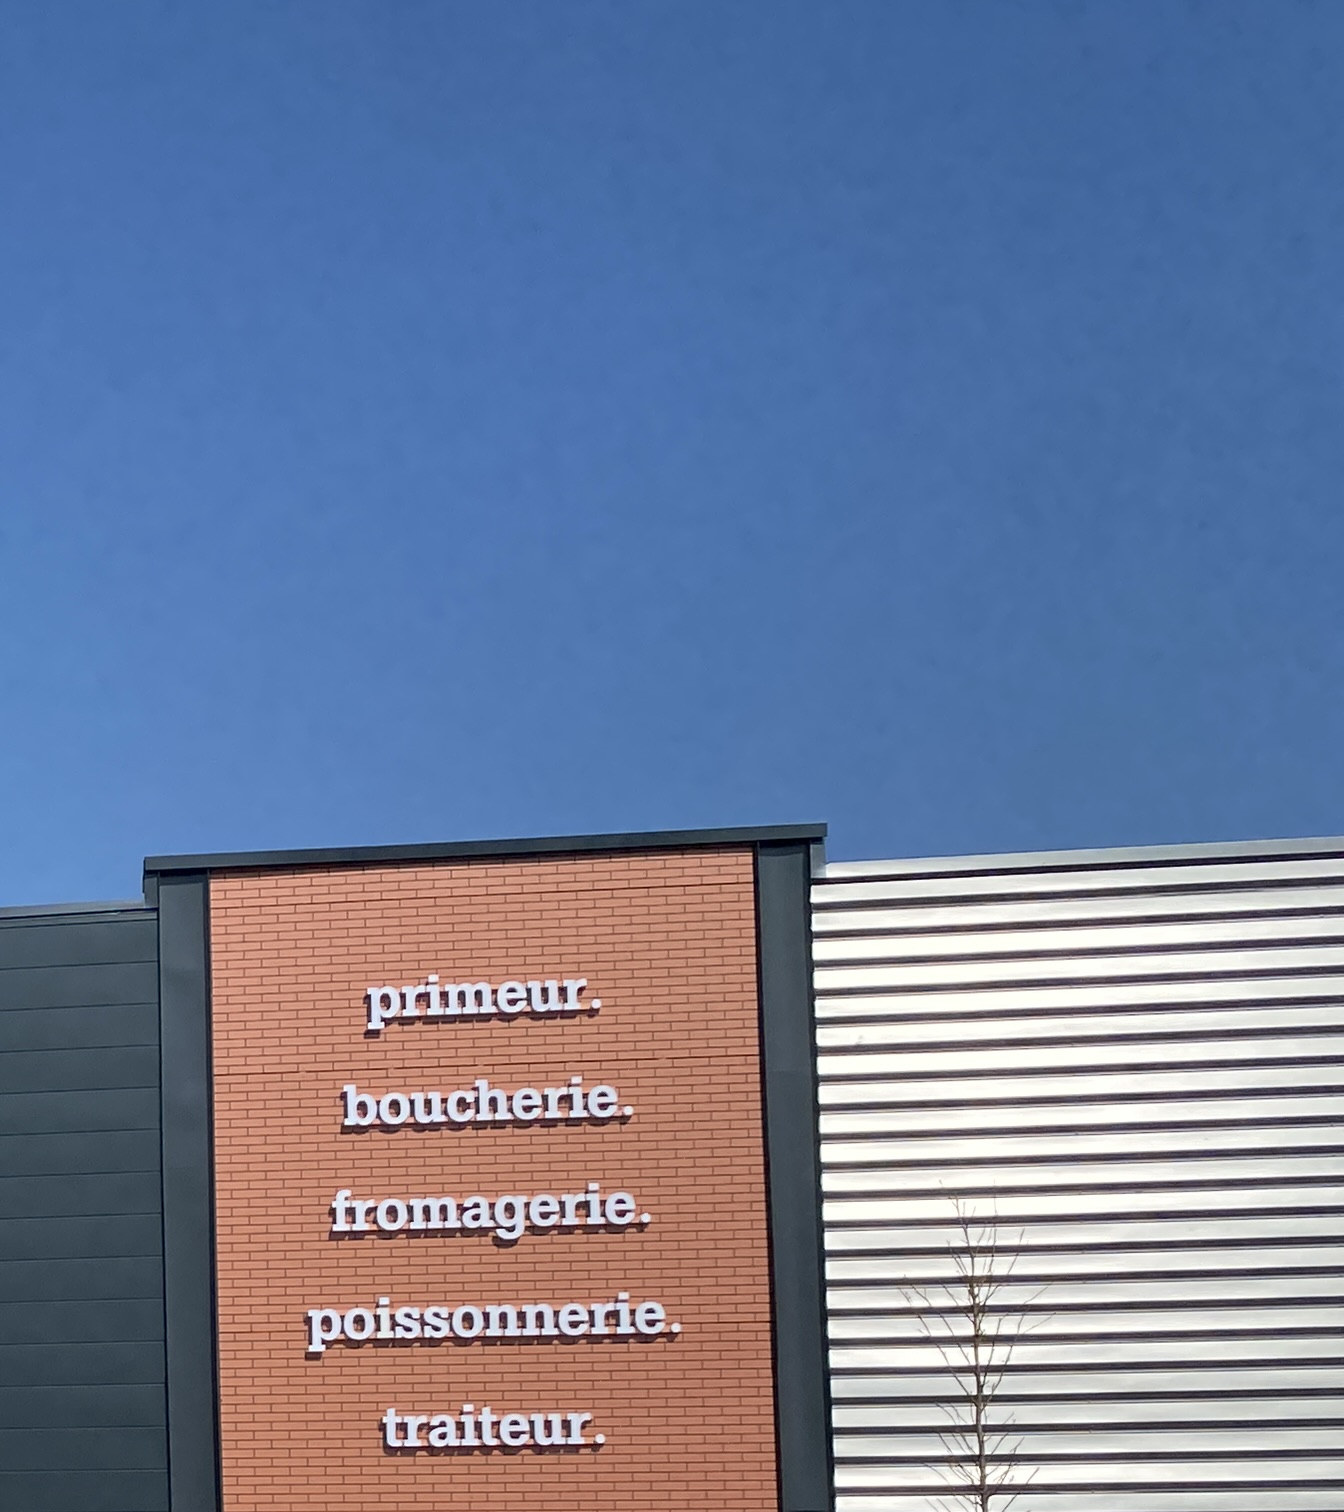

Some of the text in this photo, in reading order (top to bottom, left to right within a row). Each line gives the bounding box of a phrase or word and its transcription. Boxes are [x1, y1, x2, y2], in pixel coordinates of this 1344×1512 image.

[367, 974, 602, 1029] primeur.
[343, 1076, 634, 1126] boucherie.
[331, 1182, 651, 1239] fromagerie.
[307, 1292, 682, 1353] poissonnerie.
[382, 1404, 606, 1448] traiteur.
